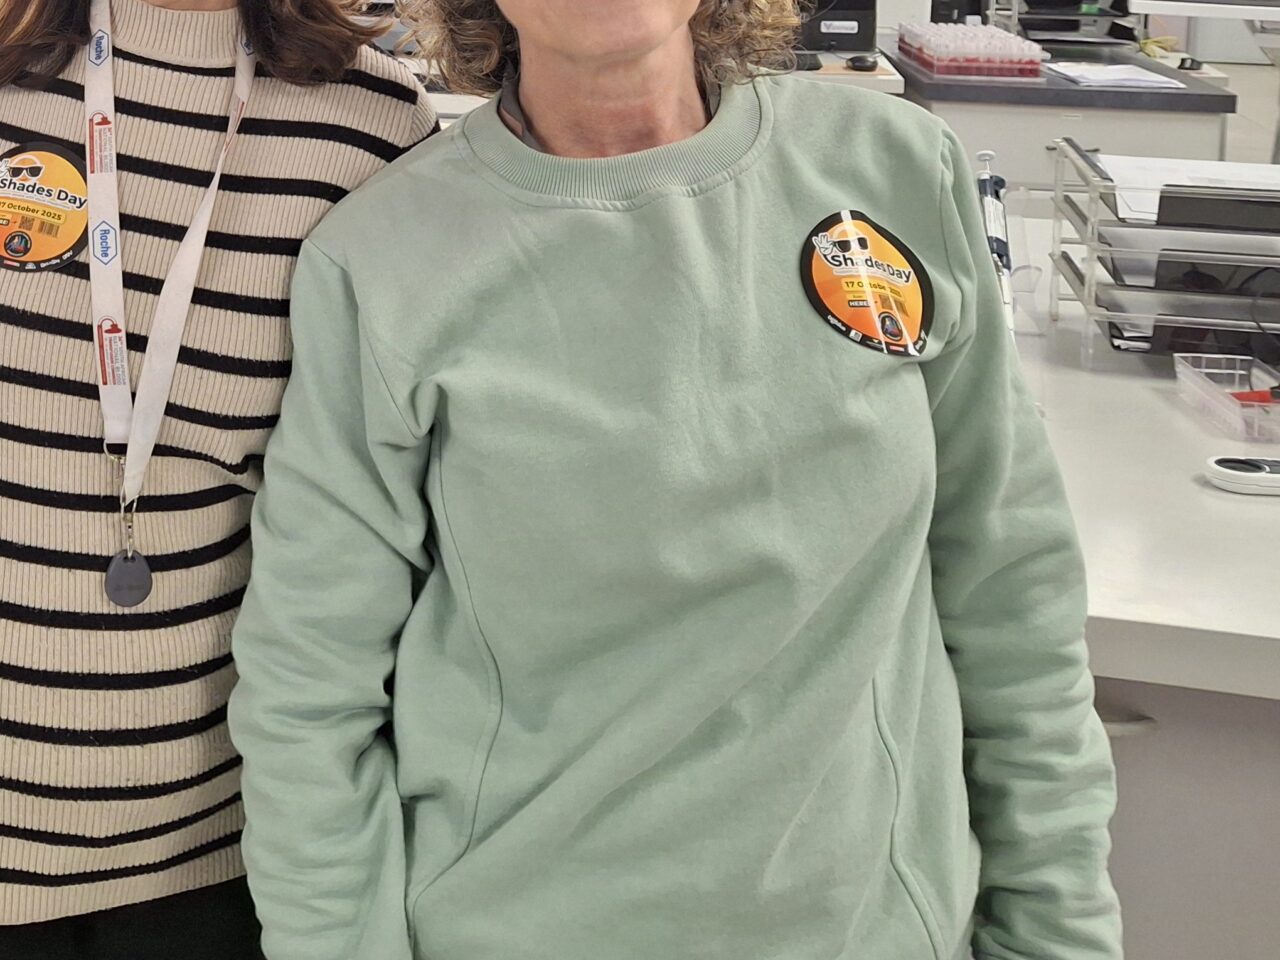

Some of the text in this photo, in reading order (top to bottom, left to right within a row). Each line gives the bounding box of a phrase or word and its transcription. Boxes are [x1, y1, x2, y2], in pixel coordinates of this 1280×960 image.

[57, 189, 87, 209] Day
[7, 203, 40, 214] October
[41, 210, 62, 221] 2025
[100, 229, 111, 258] Roche
[889, 265, 912, 284] Day
